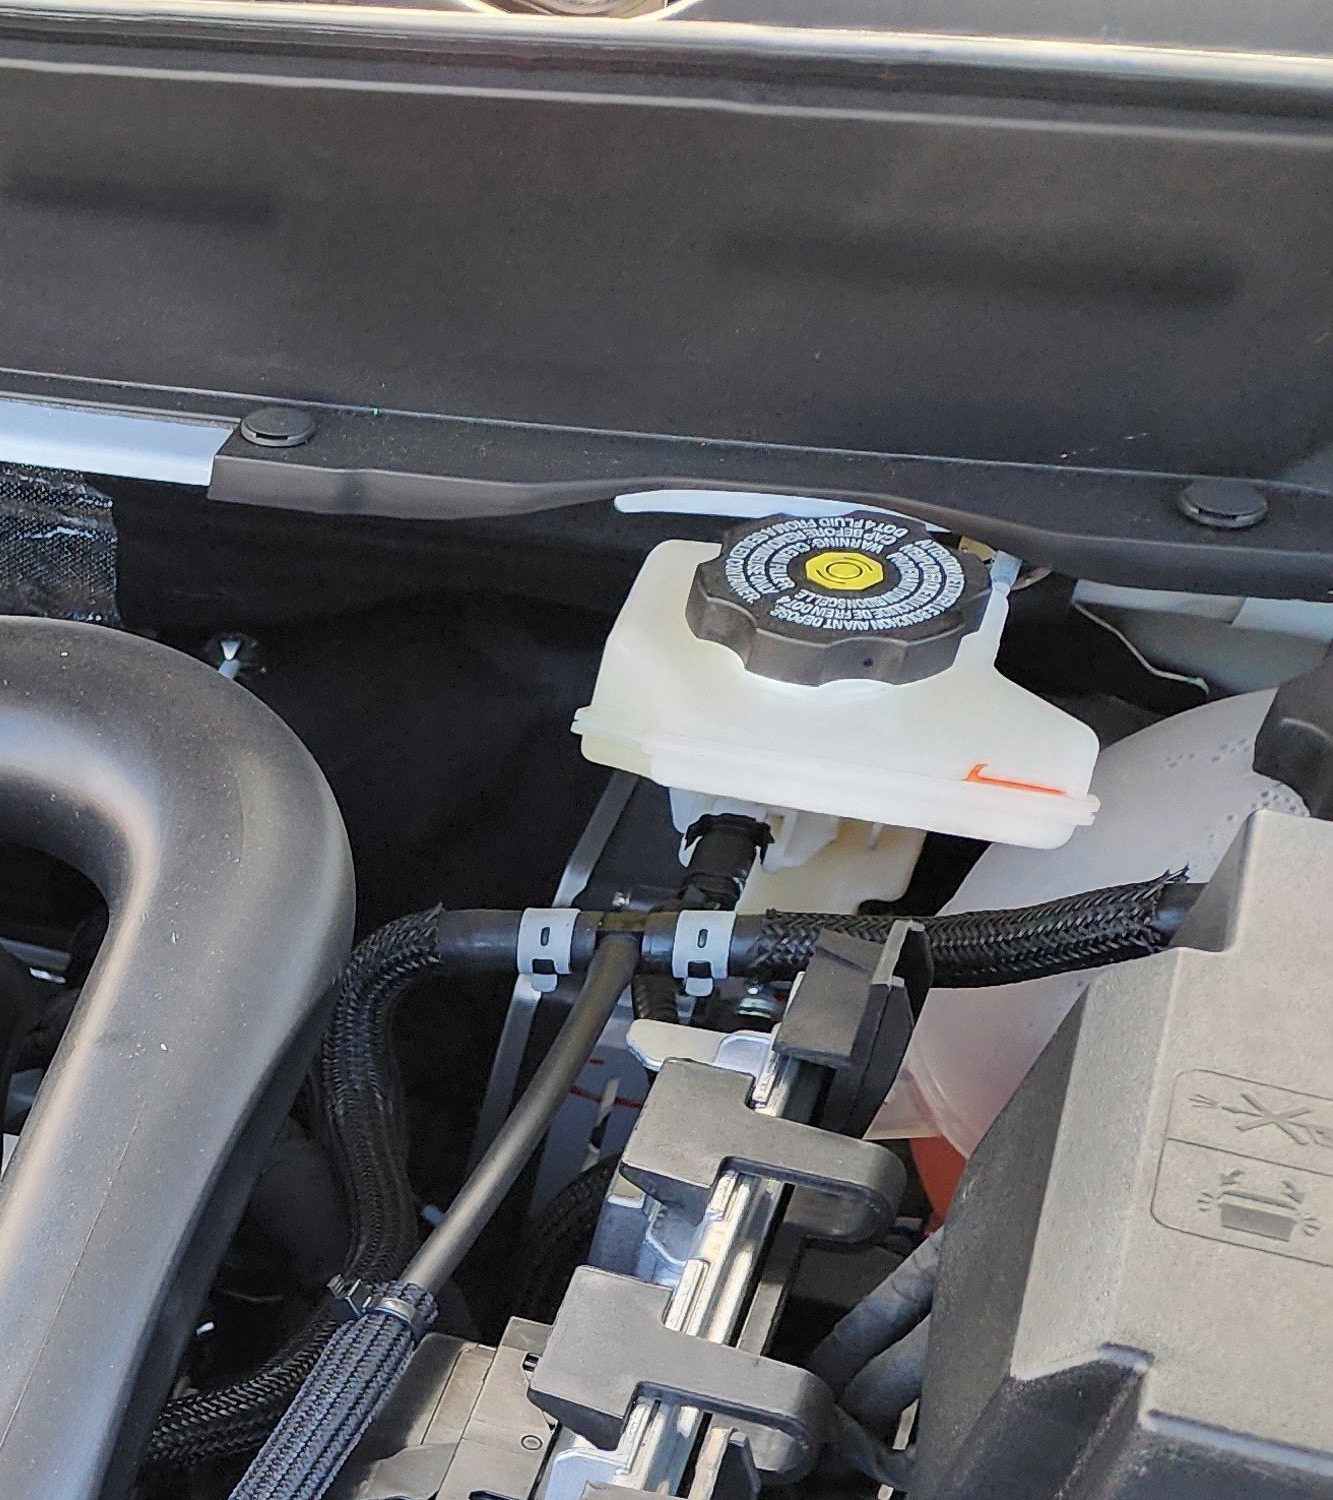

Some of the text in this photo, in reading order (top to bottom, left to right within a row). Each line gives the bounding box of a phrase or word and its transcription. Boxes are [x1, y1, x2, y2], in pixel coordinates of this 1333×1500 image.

[769, 518, 817, 533] FROM
[816, 517, 864, 527] FLUID
[872, 521, 911, 537] DOT
[801, 527, 864, 538] BEFORE
[861, 530, 900, 545] CAP
[727, 531, 770, 558] SEALED
[770, 541, 813, 564] CLEAN
[768, 562, 796, 590] FILLER
[748, 574, 780, 595] ONLY
[782, 599, 815, 612] DOT
[809, 605, 851, 618] FREIN
[851, 609, 873, 618] DE
[821, 618, 871, 629] AVANT
